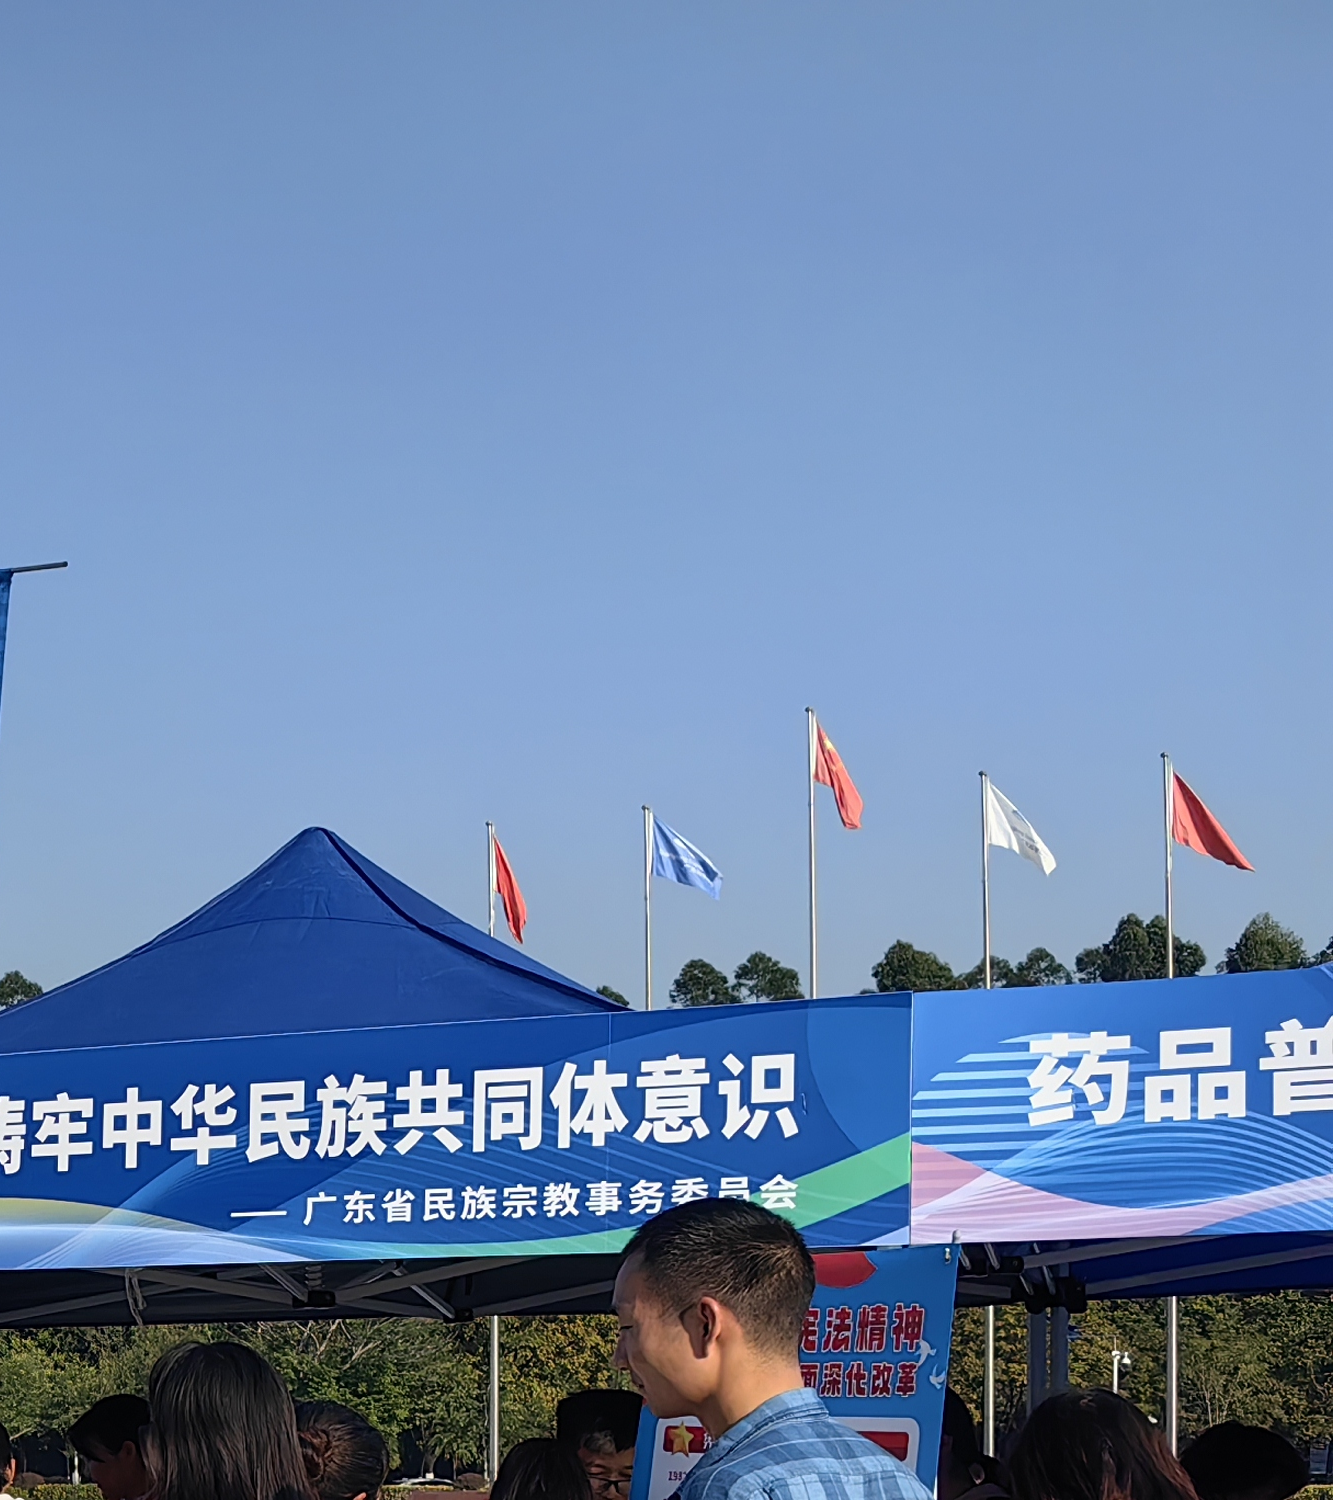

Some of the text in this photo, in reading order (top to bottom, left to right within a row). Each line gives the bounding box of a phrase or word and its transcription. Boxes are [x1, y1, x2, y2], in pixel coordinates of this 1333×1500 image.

[1028, 1015, 1333, 1128] 药品普
[800, 1303, 925, 1353] 宪法精神
[800, 1361, 919, 1398] 面深化改革
